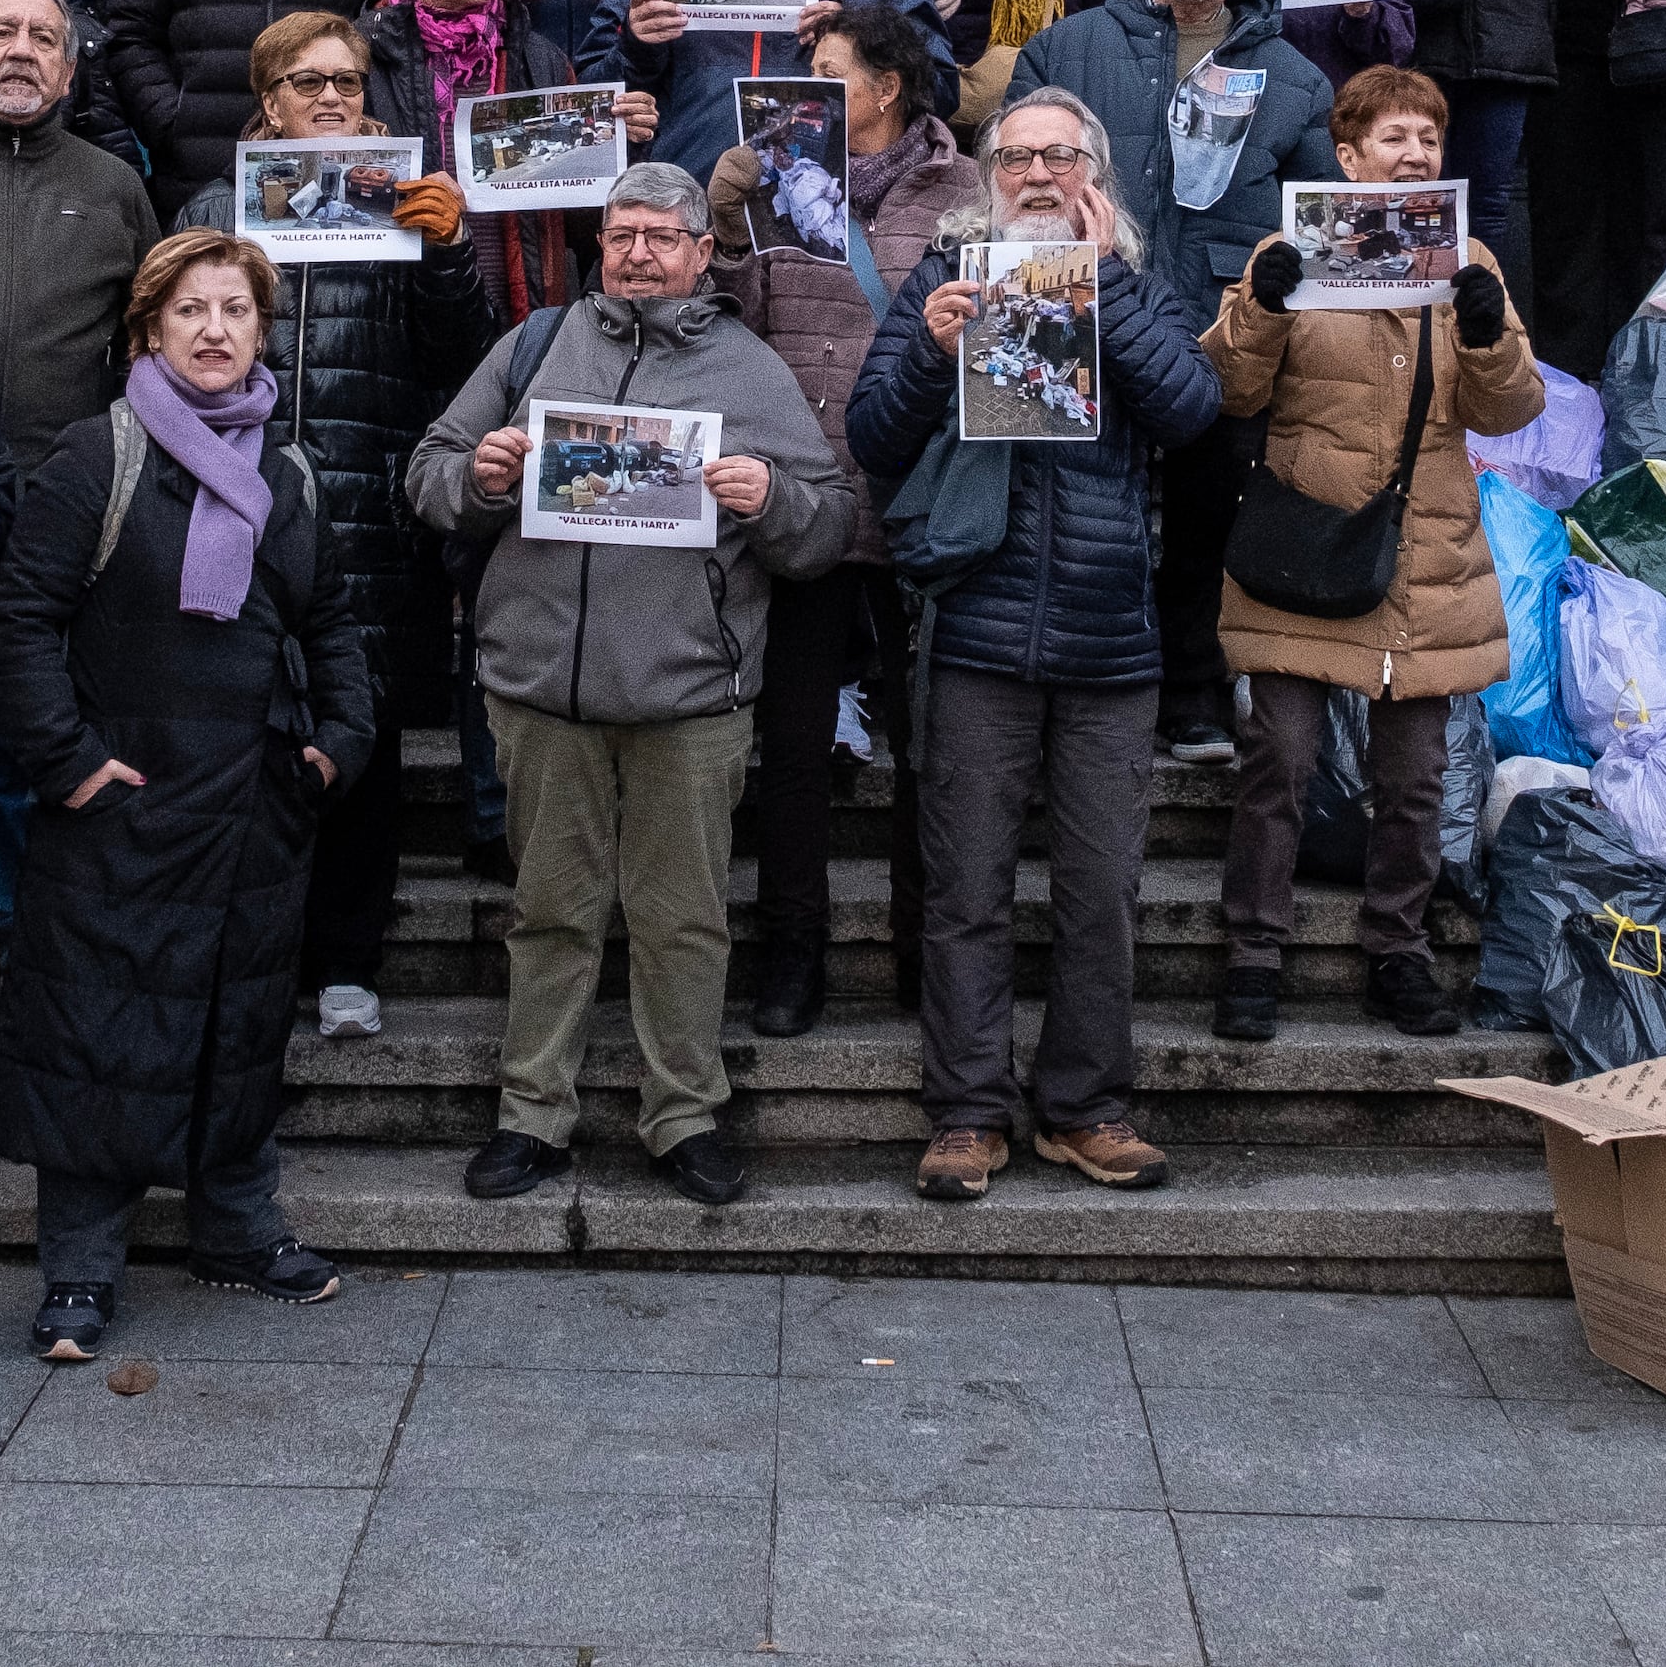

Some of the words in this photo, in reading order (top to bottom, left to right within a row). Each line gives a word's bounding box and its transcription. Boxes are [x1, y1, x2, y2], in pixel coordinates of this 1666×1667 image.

[491, 181, 538, 190] "VALLECAS
[562, 179, 596, 187] HARTA"
[349, 233, 386, 241] HARTA"
[1397, 281, 1435, 289] HARTA"
[559, 516, 612, 527] "VALLECAS
[615, 518, 638, 528] ESTA
[641, 520, 680, 530] HARTA"
